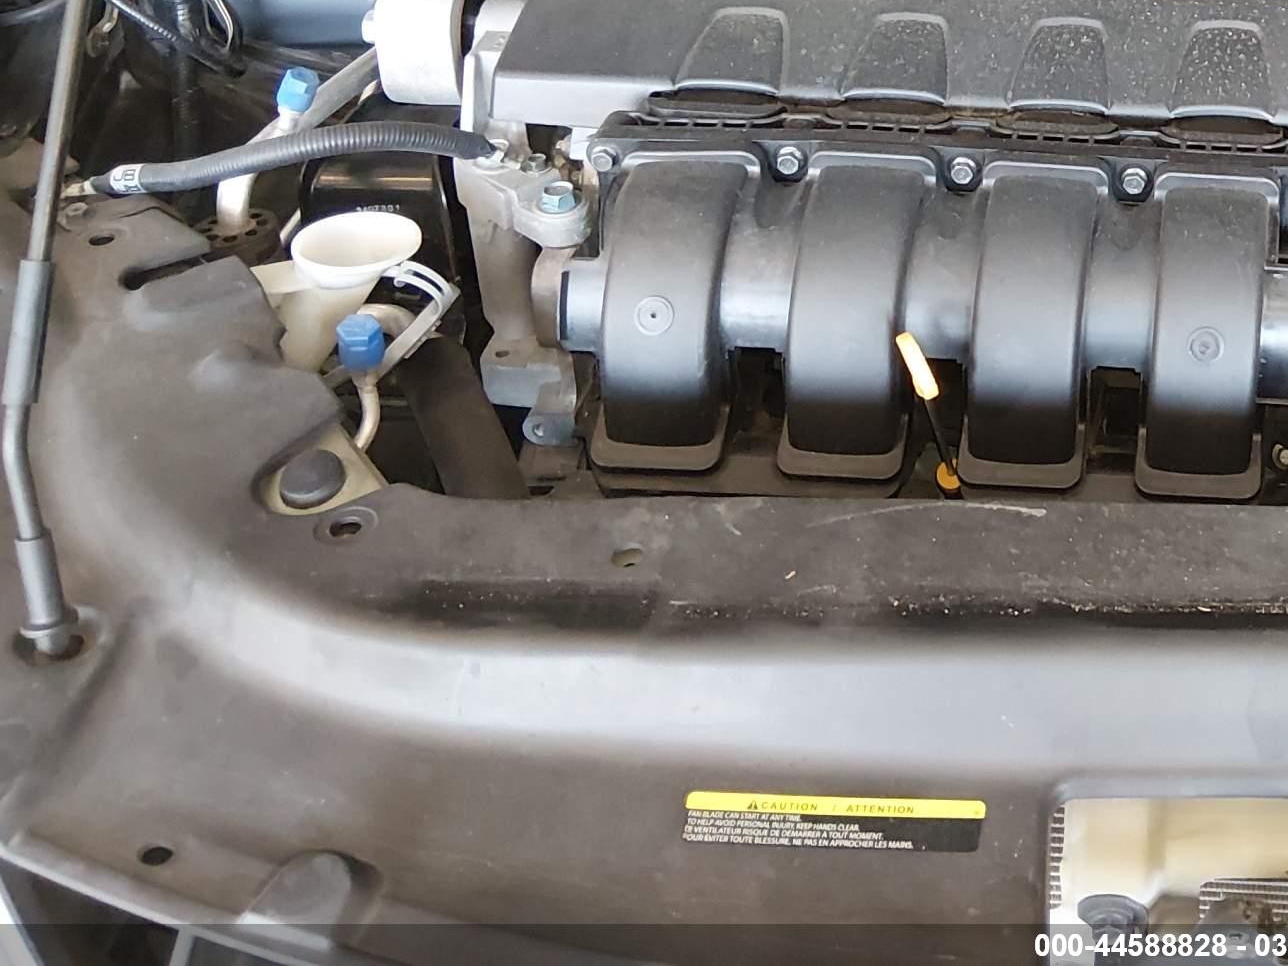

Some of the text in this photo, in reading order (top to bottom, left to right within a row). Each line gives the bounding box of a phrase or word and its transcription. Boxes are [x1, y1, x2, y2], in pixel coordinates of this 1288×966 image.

[761, 801, 818, 810] CAUTION
[846, 804, 914, 814] ATTENTION
[694, 826, 741, 835] VENTILATEUR
[829, 840, 874, 848] APPROCHER
[888, 840, 914, 849] MAINS.
